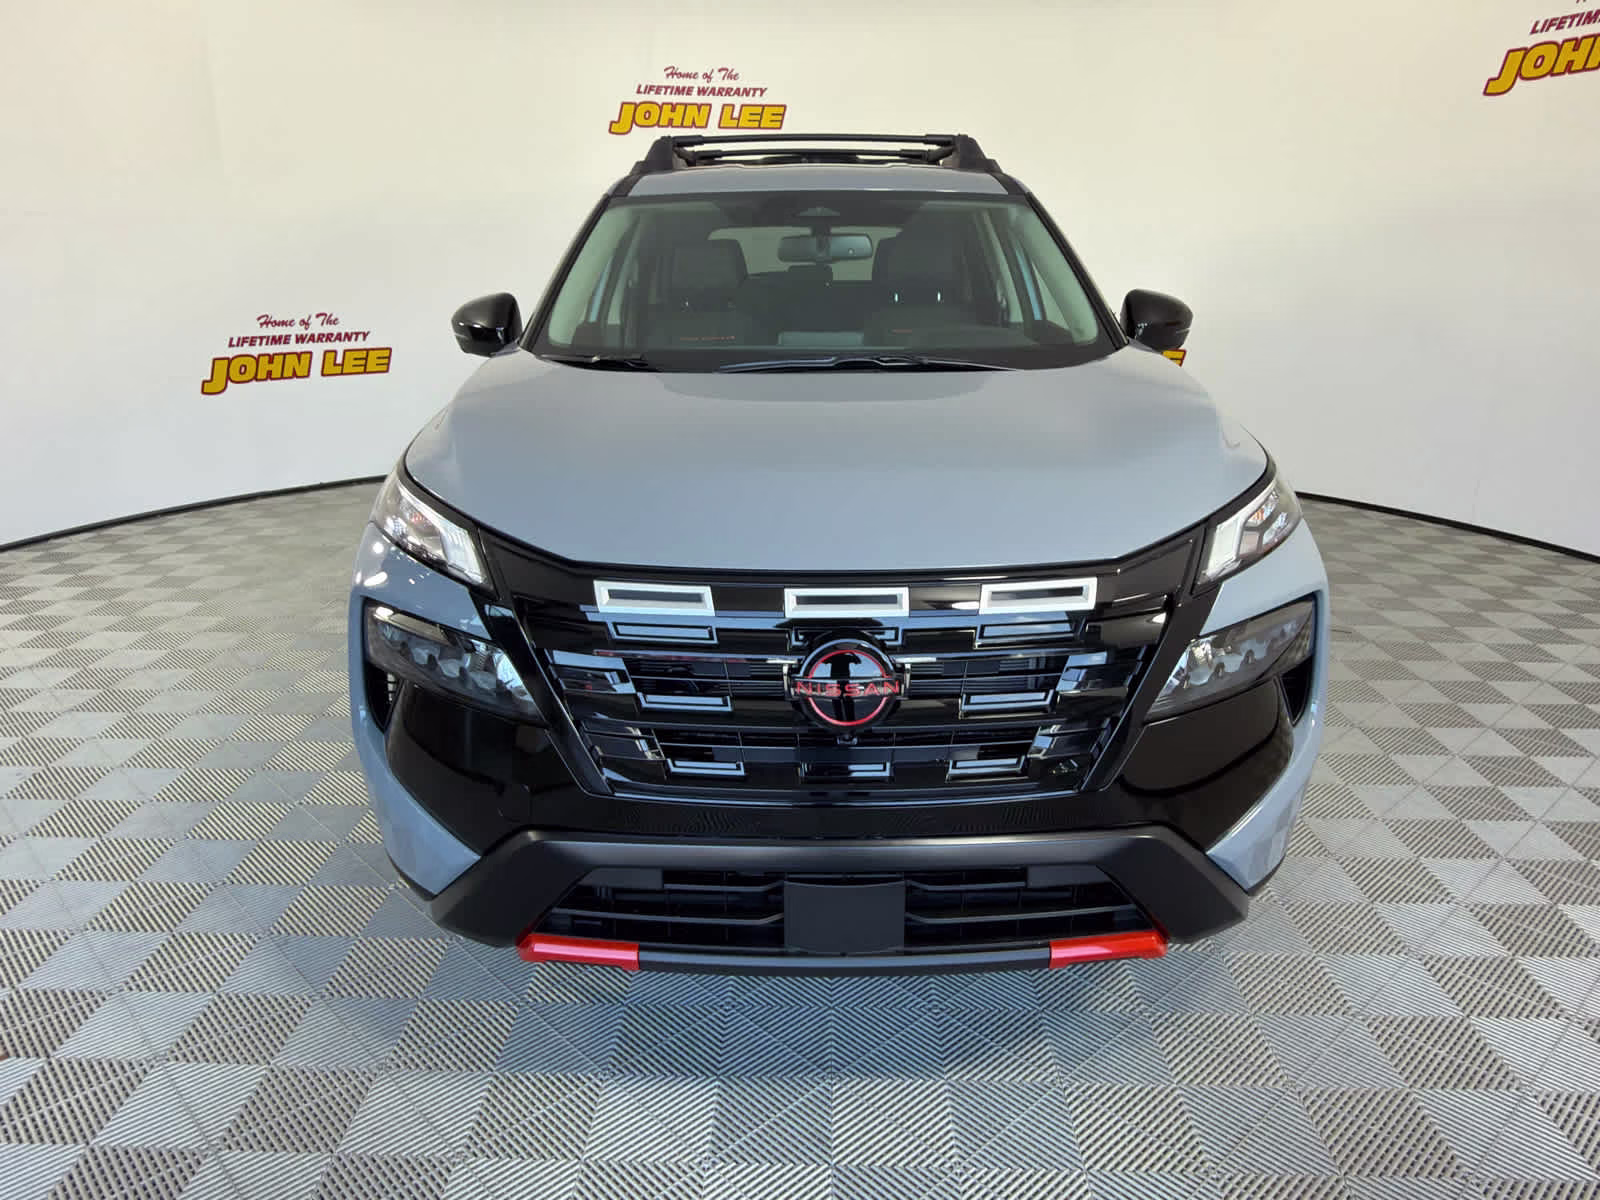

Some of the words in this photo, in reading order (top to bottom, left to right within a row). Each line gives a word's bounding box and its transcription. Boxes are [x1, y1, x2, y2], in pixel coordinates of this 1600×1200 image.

[1530, 9, 1600, 35] LIFETIM
[664, 66, 698, 80] Home
[702, 69, 714, 83] of
[718, 67, 739, 81] The
[636, 84, 694, 96] LIFETIME
[697, 87, 767, 98] WARRANTY
[608, 101, 712, 135] JOHN
[718, 104, 787, 130] LEE
[256, 314, 295, 329] Home
[299, 315, 311, 330] of
[315, 312, 339, 326] The
[228, 334, 291, 348] LIFETIME
[295, 331, 370, 345] WARRANTY
[201, 351, 313, 395] JOHN
[321, 347, 392, 376] LEE
[796, 681, 900, 697] NISSAN
